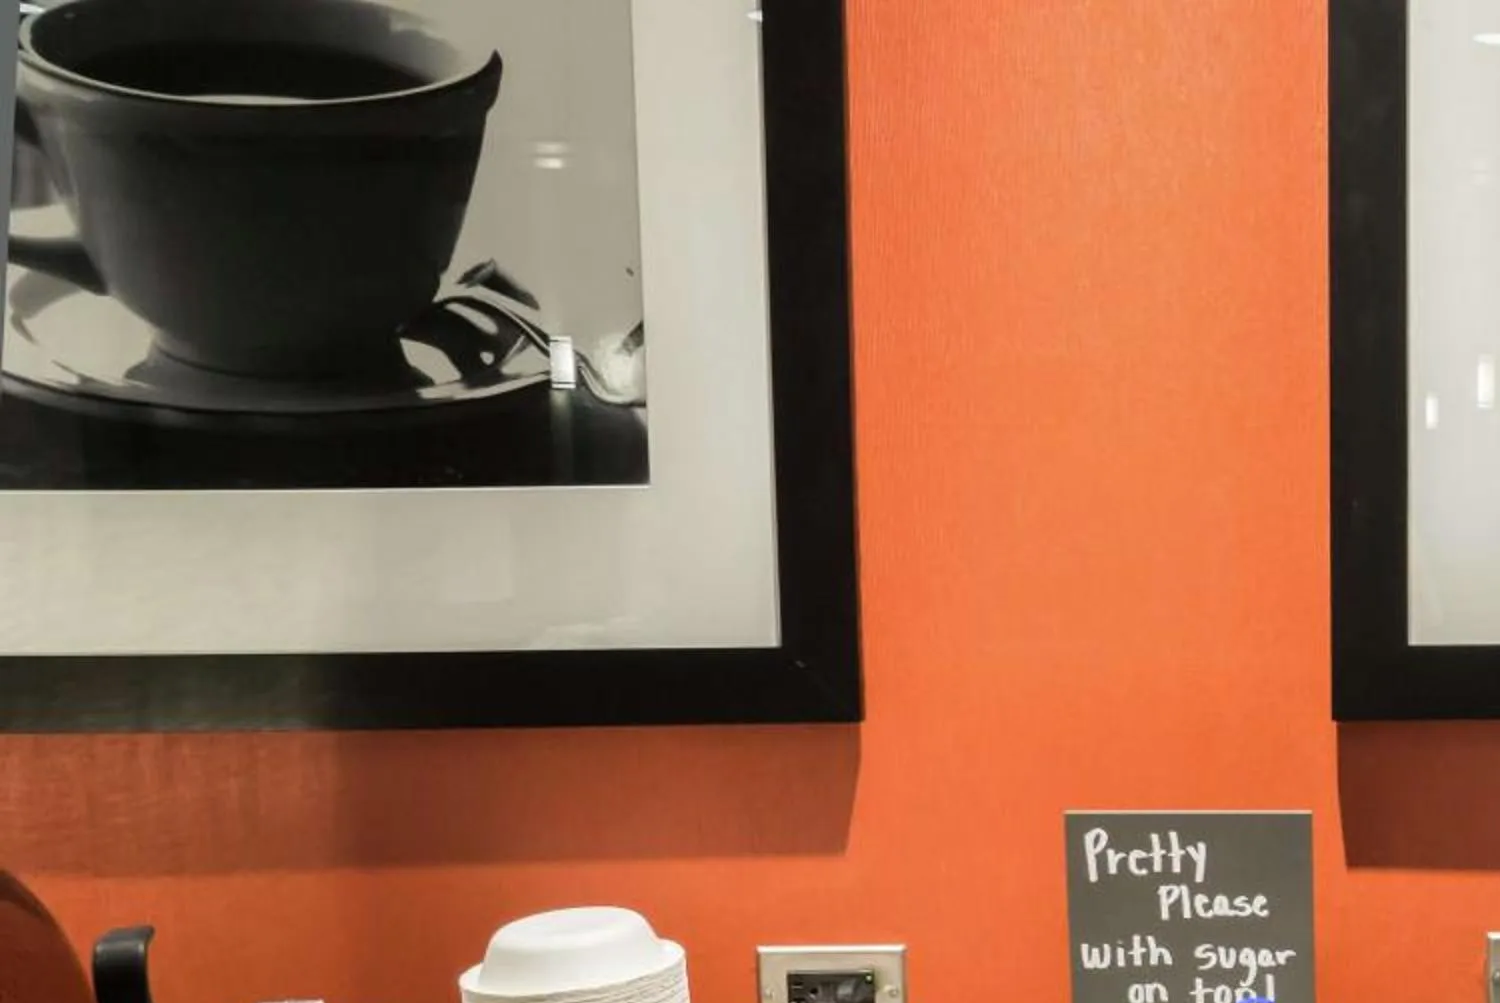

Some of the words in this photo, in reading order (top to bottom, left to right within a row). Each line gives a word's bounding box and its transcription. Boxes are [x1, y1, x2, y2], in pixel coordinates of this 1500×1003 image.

[1084, 827, 1207, 883] Pretty
[1157, 883, 1270, 921] Please
[1194, 943, 1297, 987] sugar
